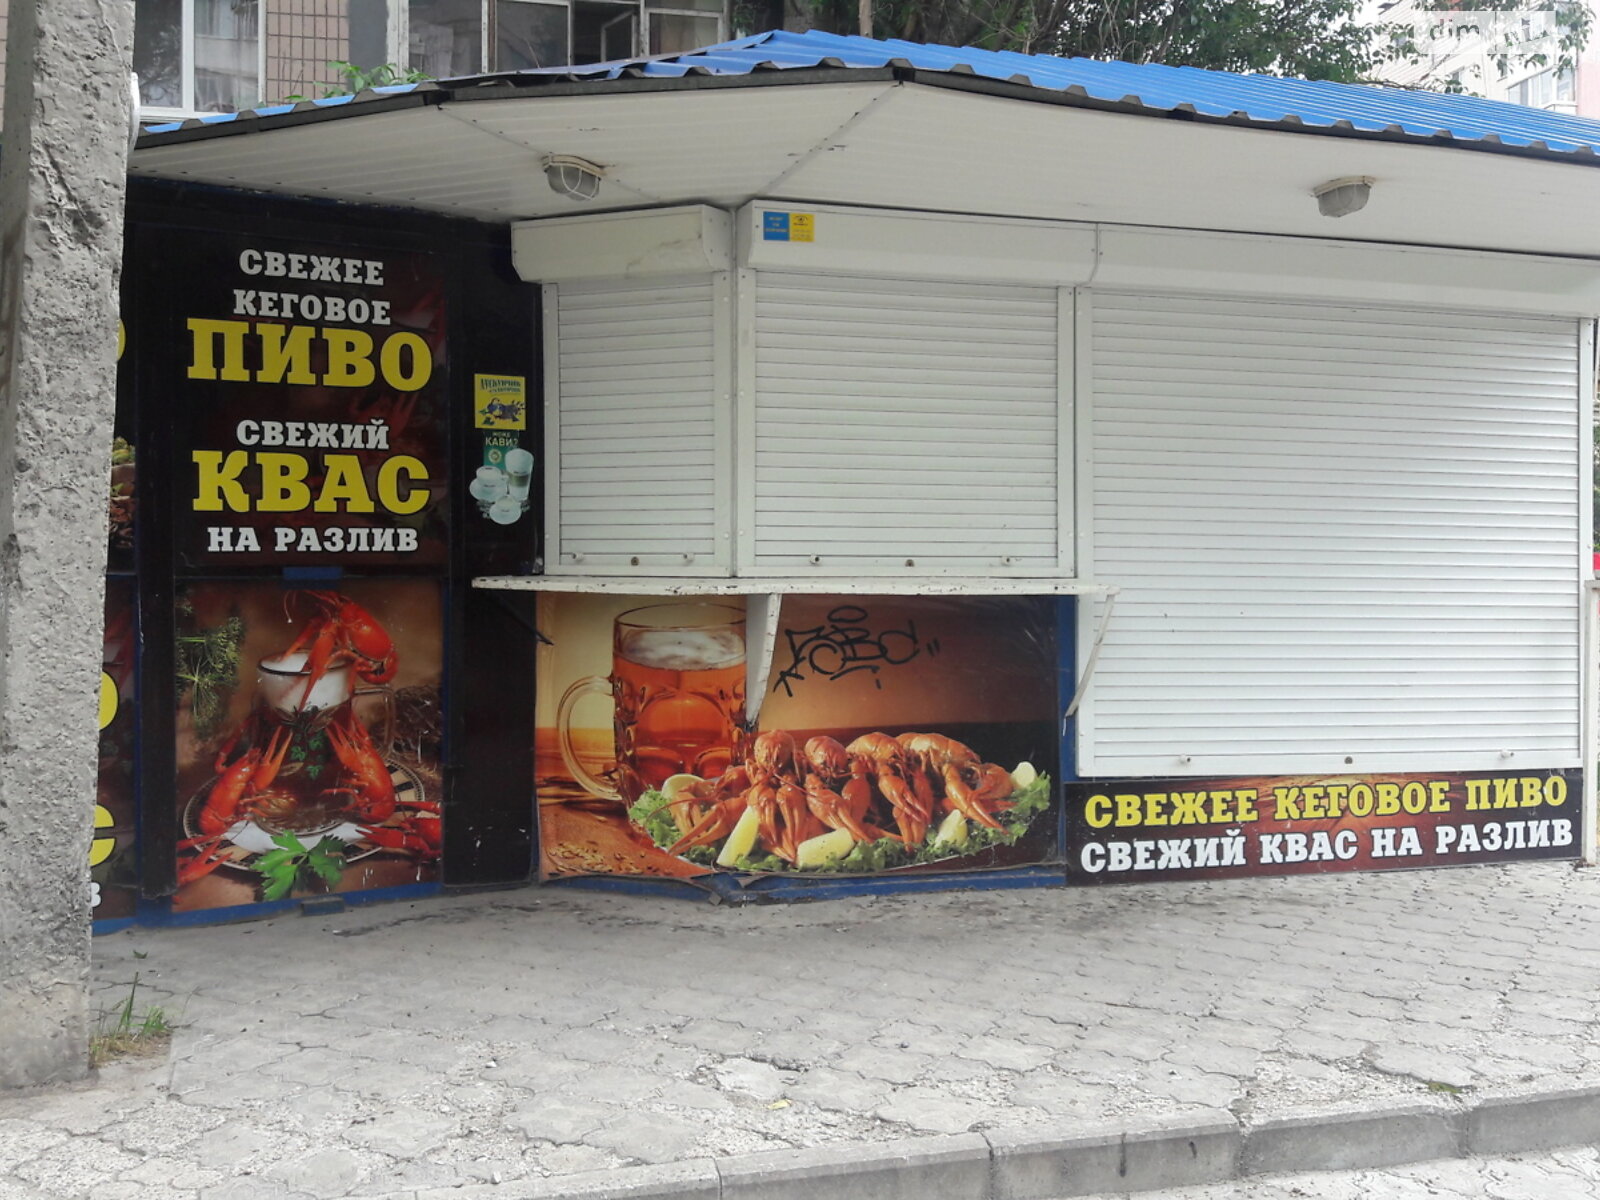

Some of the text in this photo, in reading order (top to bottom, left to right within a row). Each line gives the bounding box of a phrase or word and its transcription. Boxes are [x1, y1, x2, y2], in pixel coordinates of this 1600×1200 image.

[239, 248, 385, 286] СВЕЖЕЕ
[232, 288, 392, 326] КЕГОВОЕ
[187, 317, 433, 392] ПИВО
[236, 418, 390, 450] СВЕЖИЙ
[191, 449, 431, 515] КВАС
[206, 526, 419, 553] НА РАЗЛИВ
[1083, 775, 1568, 829] СВЕЖЕЕ КЕГОВОЕ ПИВО
[1080, 818, 1575, 873] СВЕЖИЙ КВАС НА РАЗЛИВ
